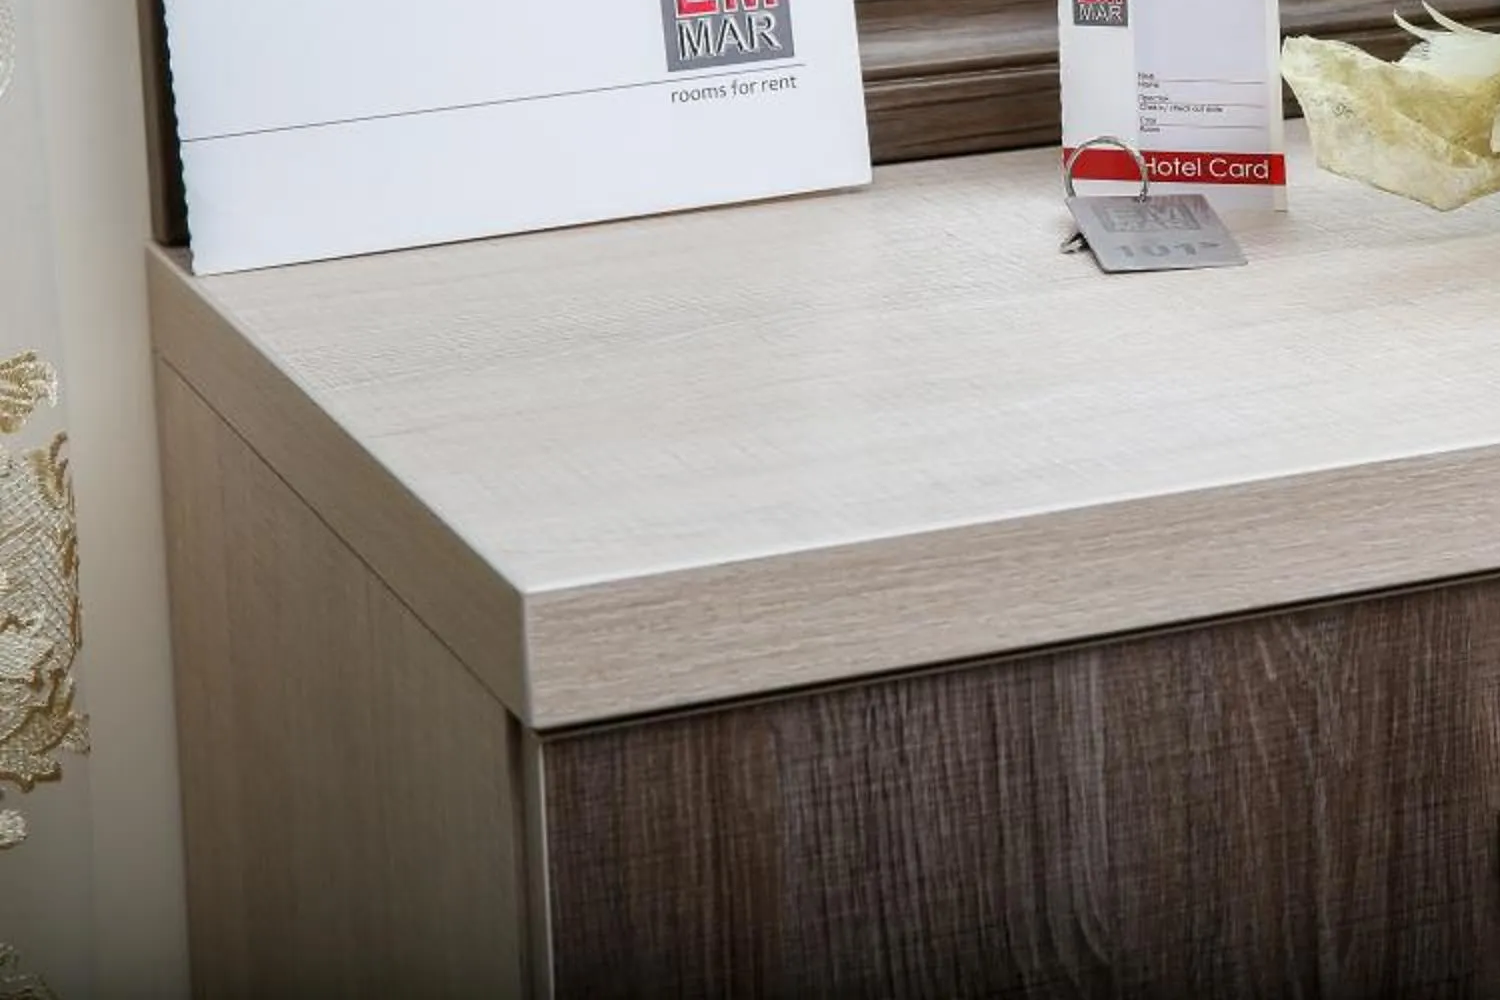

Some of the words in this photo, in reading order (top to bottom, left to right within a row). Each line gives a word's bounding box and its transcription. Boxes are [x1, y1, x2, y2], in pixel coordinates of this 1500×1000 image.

[1080, 3, 1122, 21] MAR
[677, 10, 783, 61] MAR
[671, 85, 727, 103] rooms
[730, 79, 758, 97] for
[760, 77, 797, 93] rent
[1144, 157, 1202, 177] Hotel
[1209, 158, 1269, 179] Card
